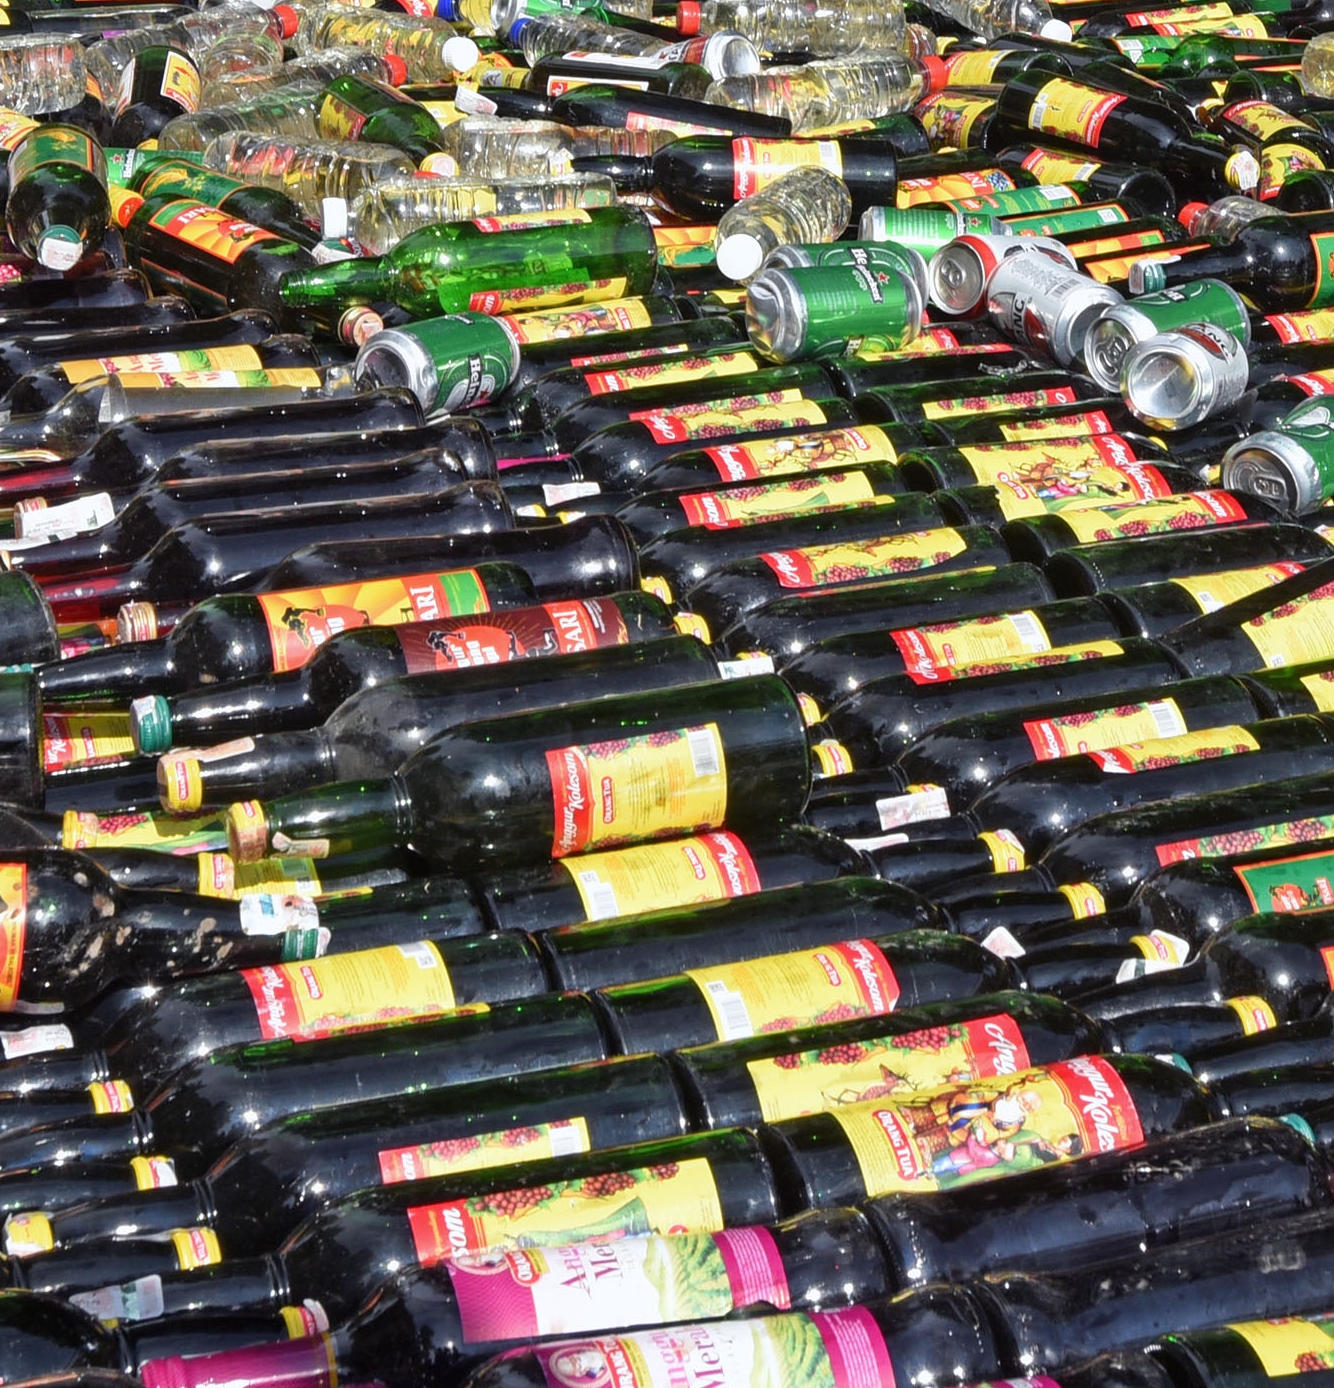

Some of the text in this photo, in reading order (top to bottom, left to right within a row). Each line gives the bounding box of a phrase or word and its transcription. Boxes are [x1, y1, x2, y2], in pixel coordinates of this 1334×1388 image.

[561, 751, 584, 852] Anggur Kolesom
[604, 778, 612, 822] ORANG TUA
[878, 1111, 914, 1177] ORANG TUA
